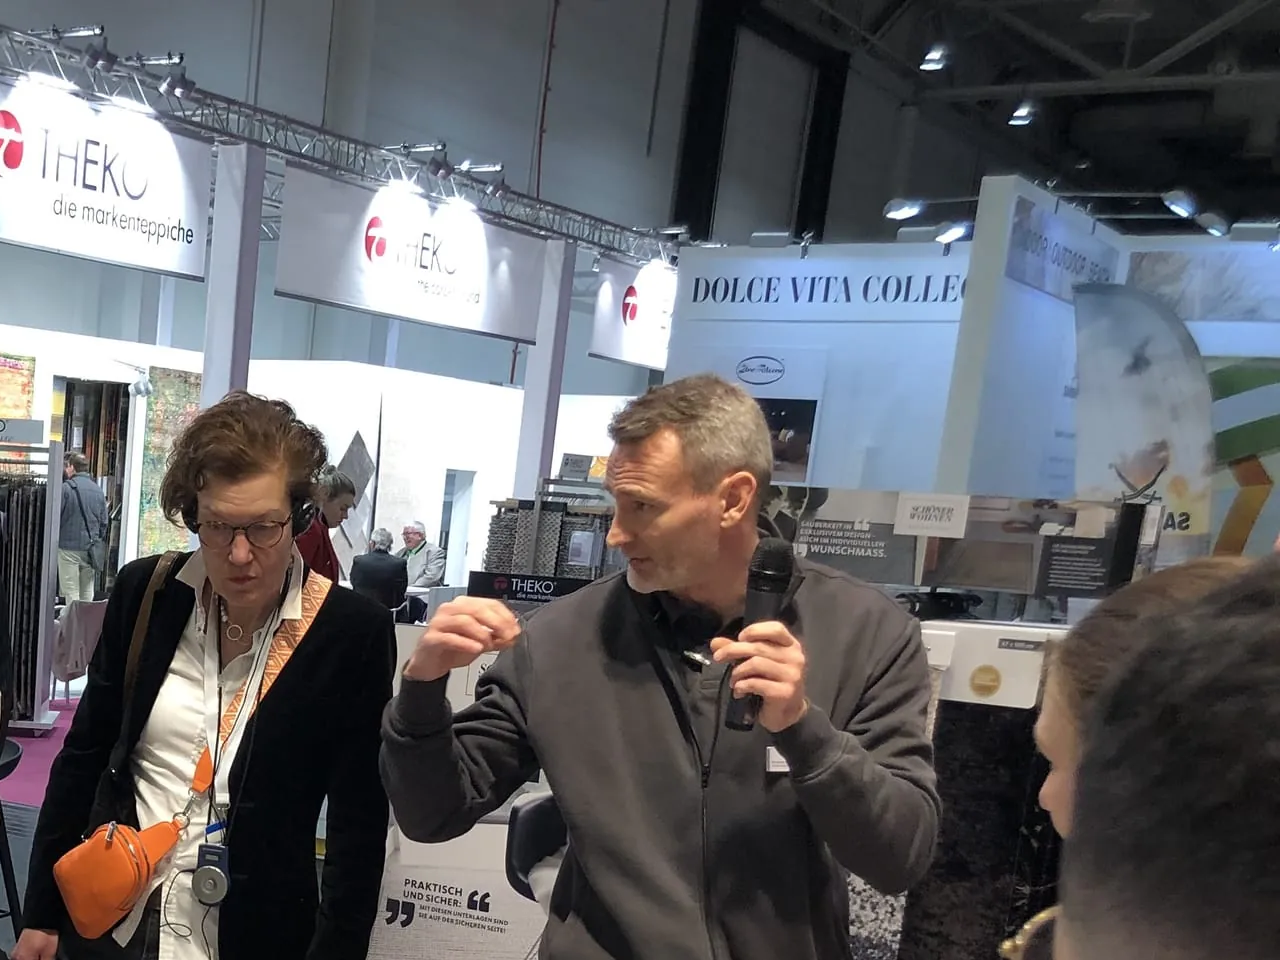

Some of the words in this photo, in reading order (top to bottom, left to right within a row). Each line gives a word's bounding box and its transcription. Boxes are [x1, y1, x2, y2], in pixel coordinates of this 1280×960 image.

[53, 193, 77, 218] die
[82, 204, 193, 245] markenteppiche
[692, 276, 781, 303] DOLCE
[790, 275, 851, 303] VITA
[810, 544, 887, 558] WUNSCHMASS.
[511, 578, 554, 593] THEKO
[404, 879, 462, 896] PRAKTISCH
[403, 890, 423, 901] UND
[425, 894, 461, 907] SICHER:
[431, 906, 452, 916] DIESEN
[453, 910, 493, 922] UNTERLAGEN
[493, 918, 509, 926] SIND
[455, 919, 486, 930] SICHEREN
